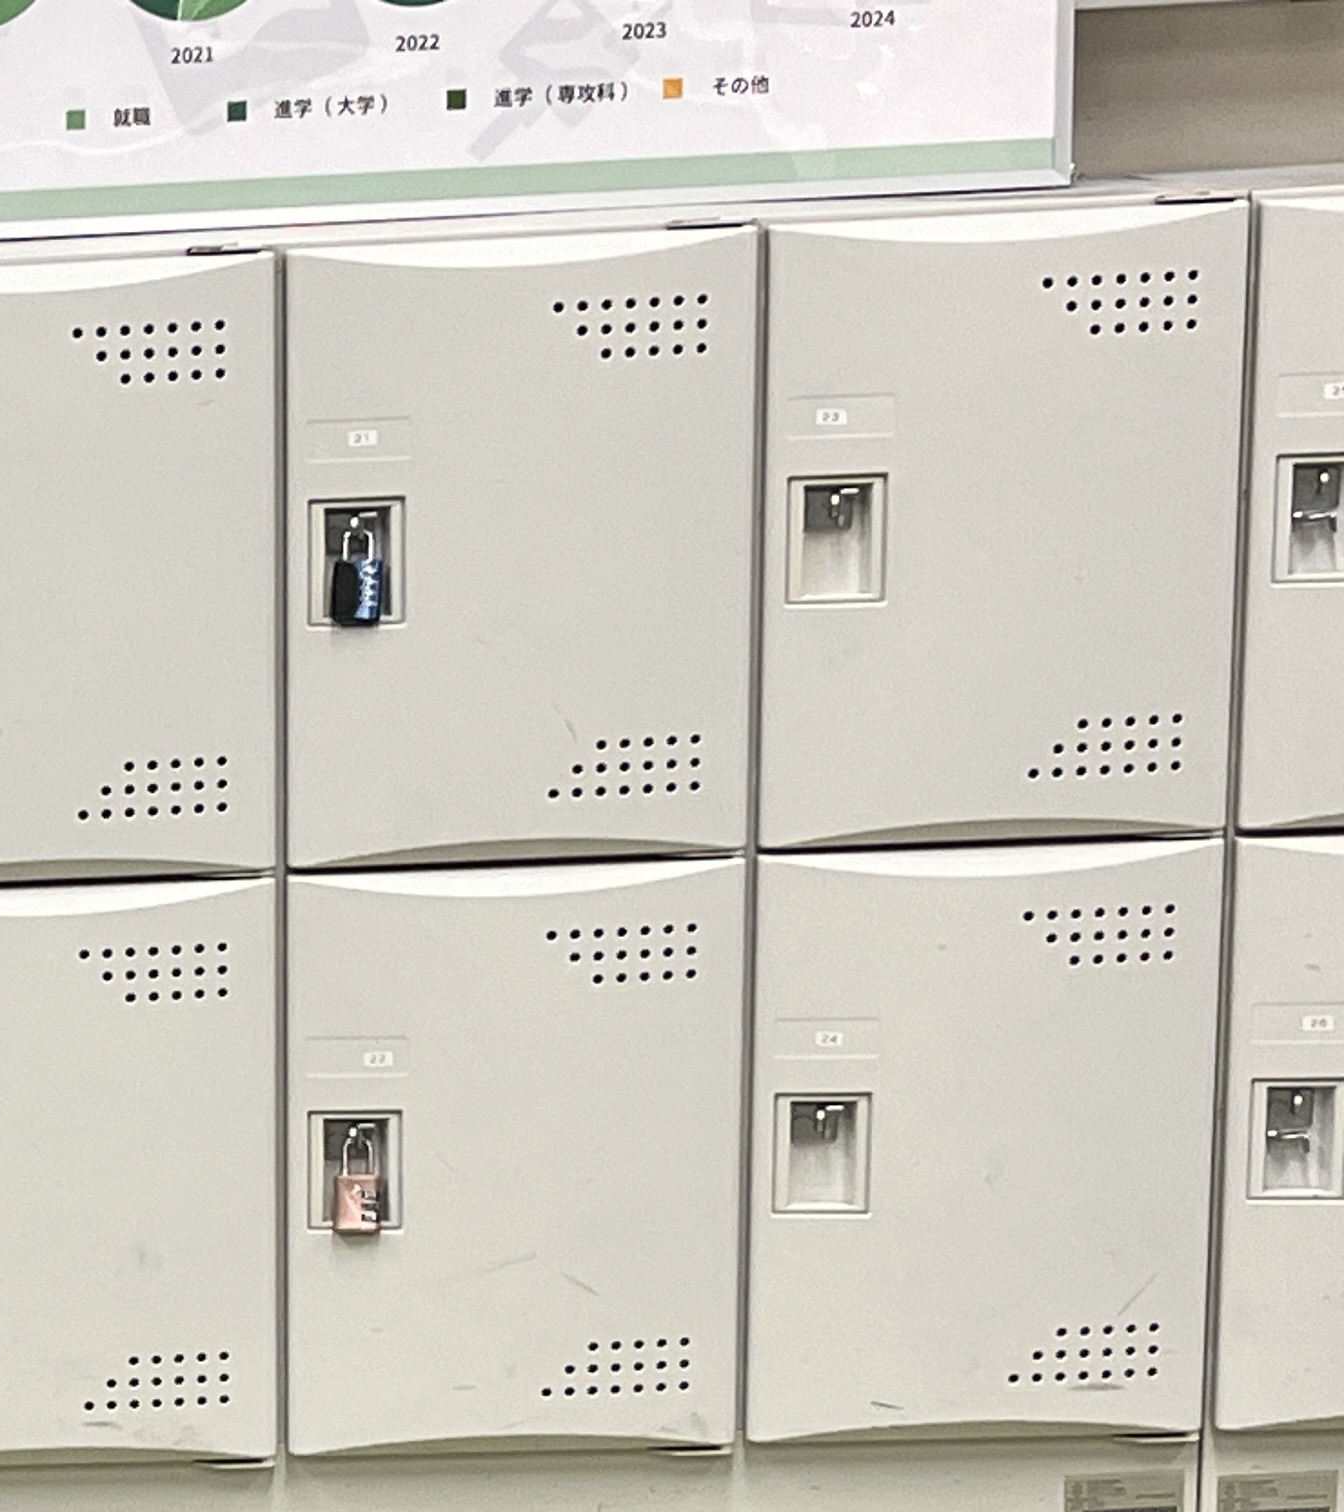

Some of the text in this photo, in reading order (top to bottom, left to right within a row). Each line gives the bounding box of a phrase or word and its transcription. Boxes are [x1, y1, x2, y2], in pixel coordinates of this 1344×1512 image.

[850, 10, 896, 29] 2024
[621, 22, 667, 40] 2023
[395, 34, 440, 52] 2022
[171, 46, 213, 64] 2021
[712, 75, 770, 96] その他
